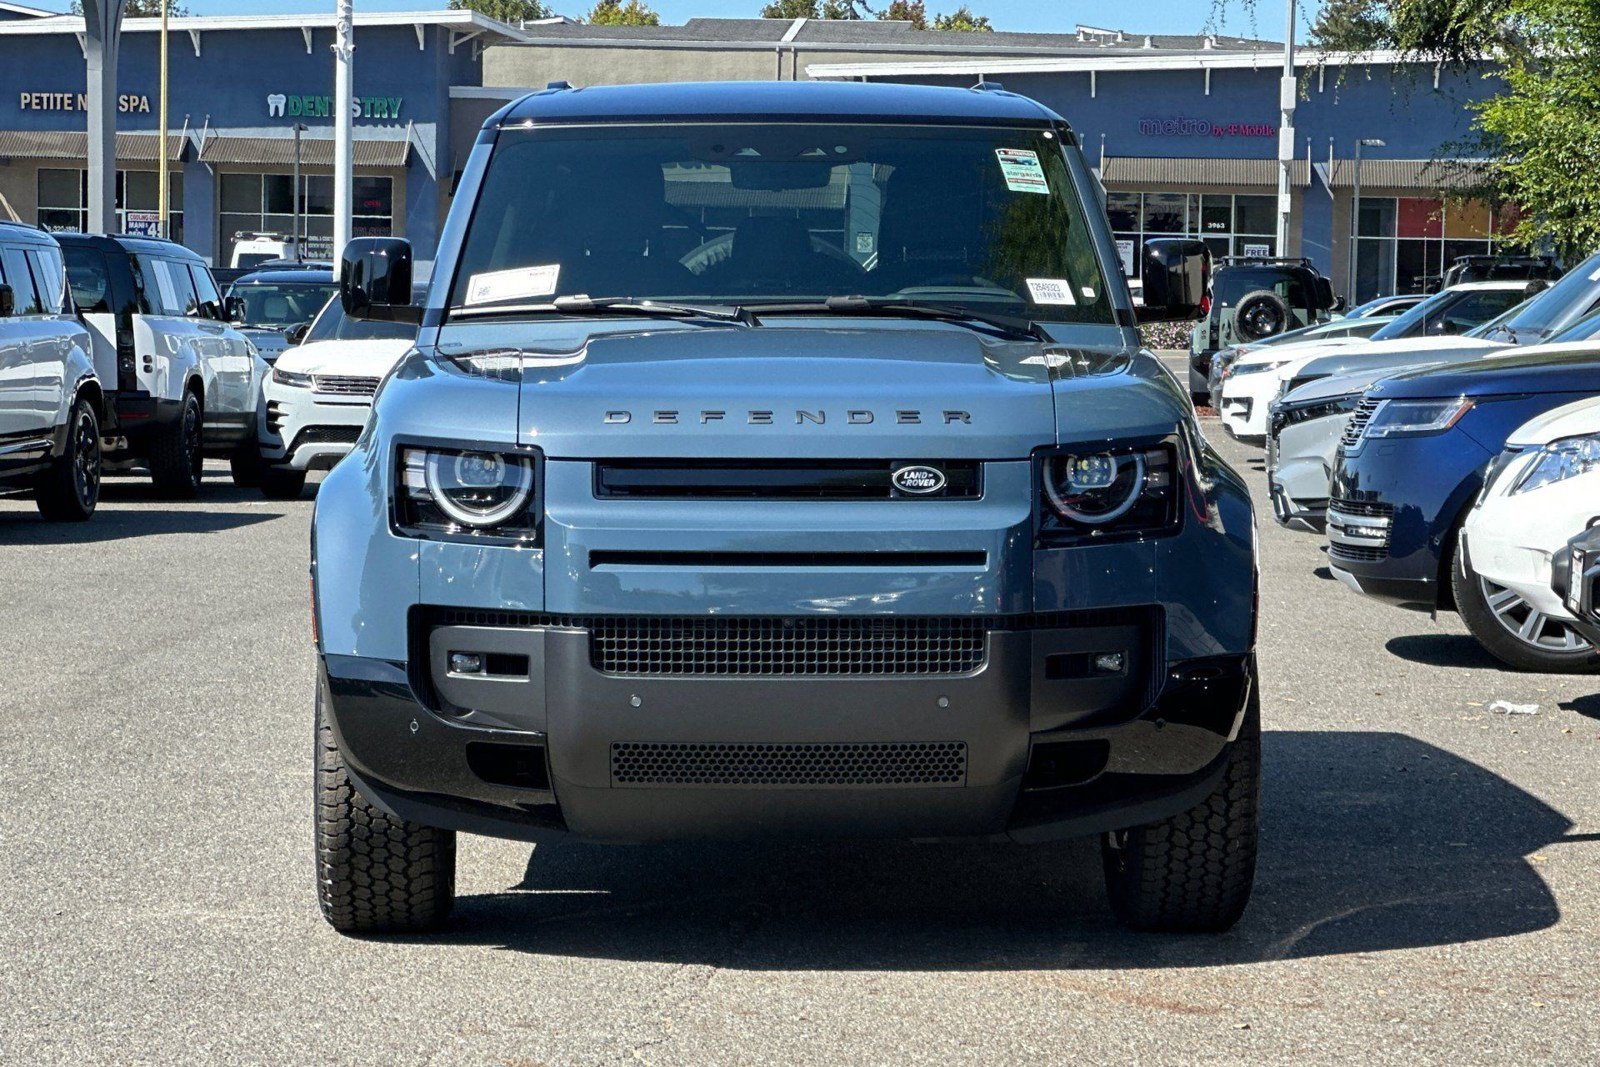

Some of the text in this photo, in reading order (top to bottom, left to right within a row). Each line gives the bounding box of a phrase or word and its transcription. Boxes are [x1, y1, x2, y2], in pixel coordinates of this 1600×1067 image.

[20, 93, 73, 110] PETITE
[118, 94, 150, 112] SPA
[288, 95, 402, 118] DENTSTRY
[1139, 116, 1210, 136] metro
[1212, 125, 1224, 138] by
[1245, 249, 1268, 257] FREE
[603, 409, 973, 425] DEFENDER
[903, 471, 928, 480] LAND
[905, 478, 936, 487] ROVER
